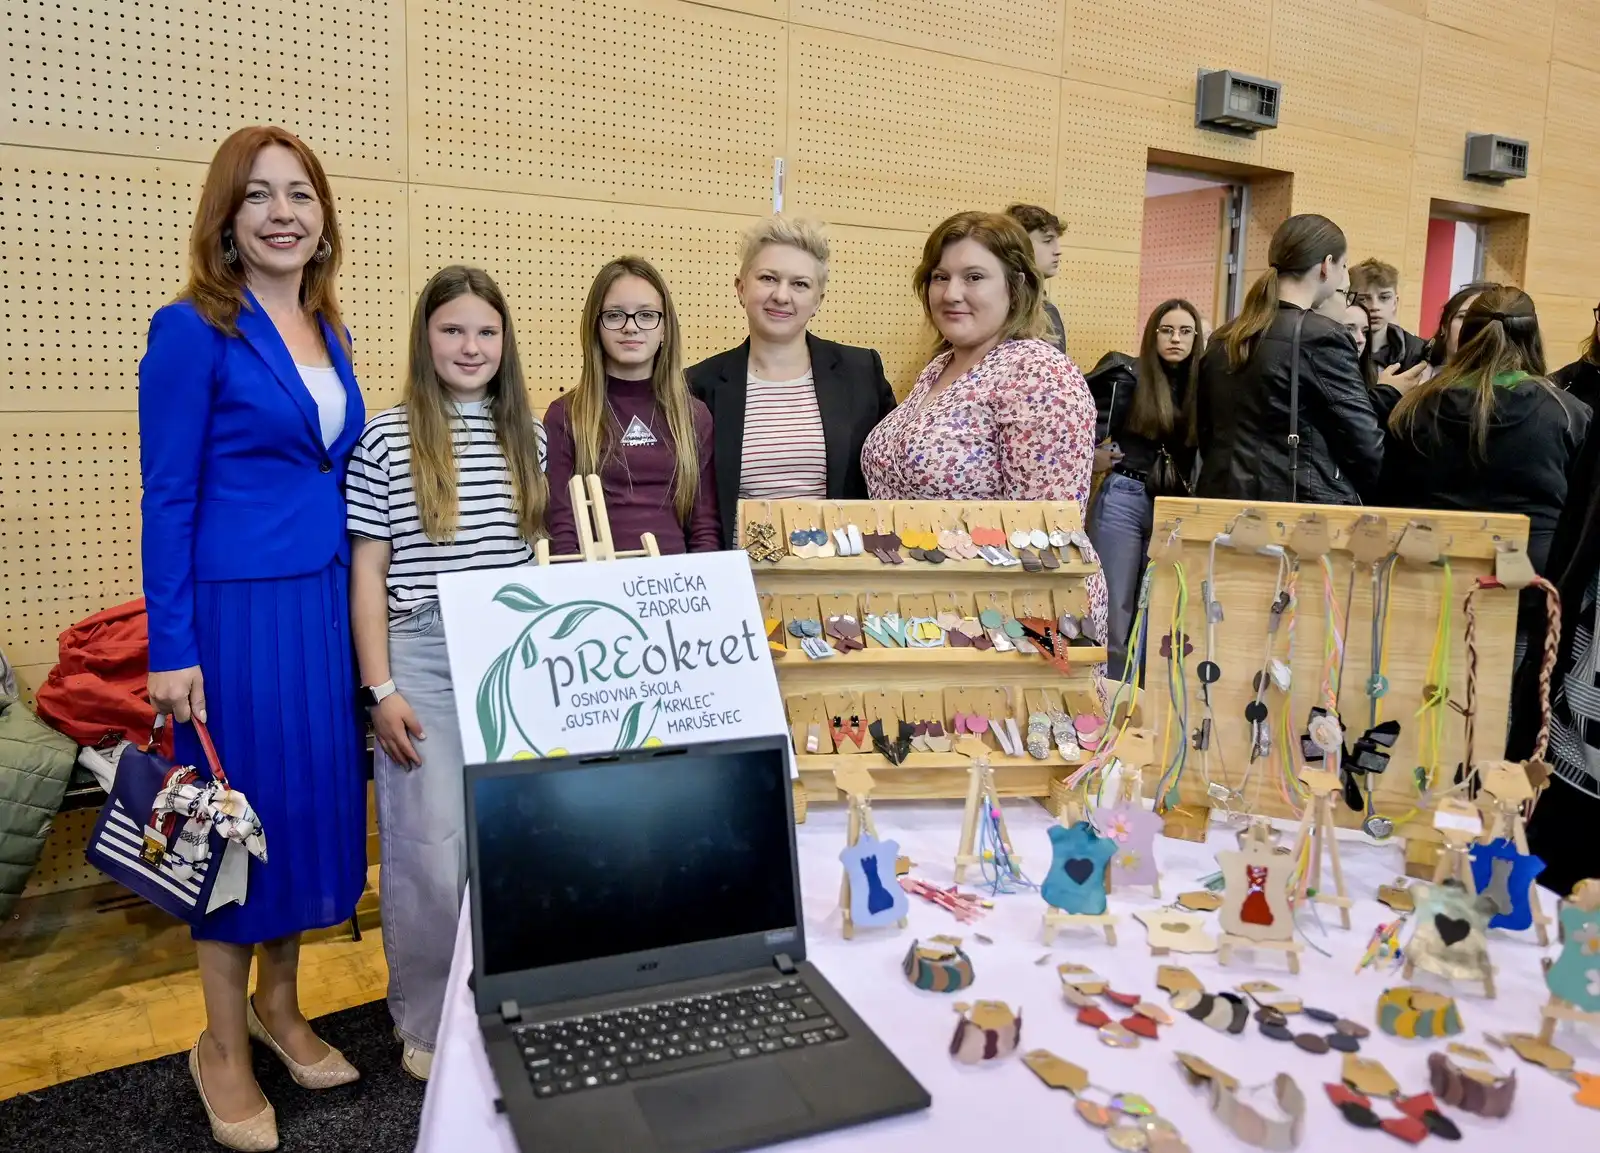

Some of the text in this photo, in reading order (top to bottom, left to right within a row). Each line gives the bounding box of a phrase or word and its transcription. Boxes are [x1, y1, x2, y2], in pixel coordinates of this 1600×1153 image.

[623, 572, 707, 597] UČENIČKA
[636, 595, 711, 618] ZADRUGA
[571, 680, 682, 708] OSNOVNA ŠKOLA
[667, 709, 742, 734] MARUŠEVEC
